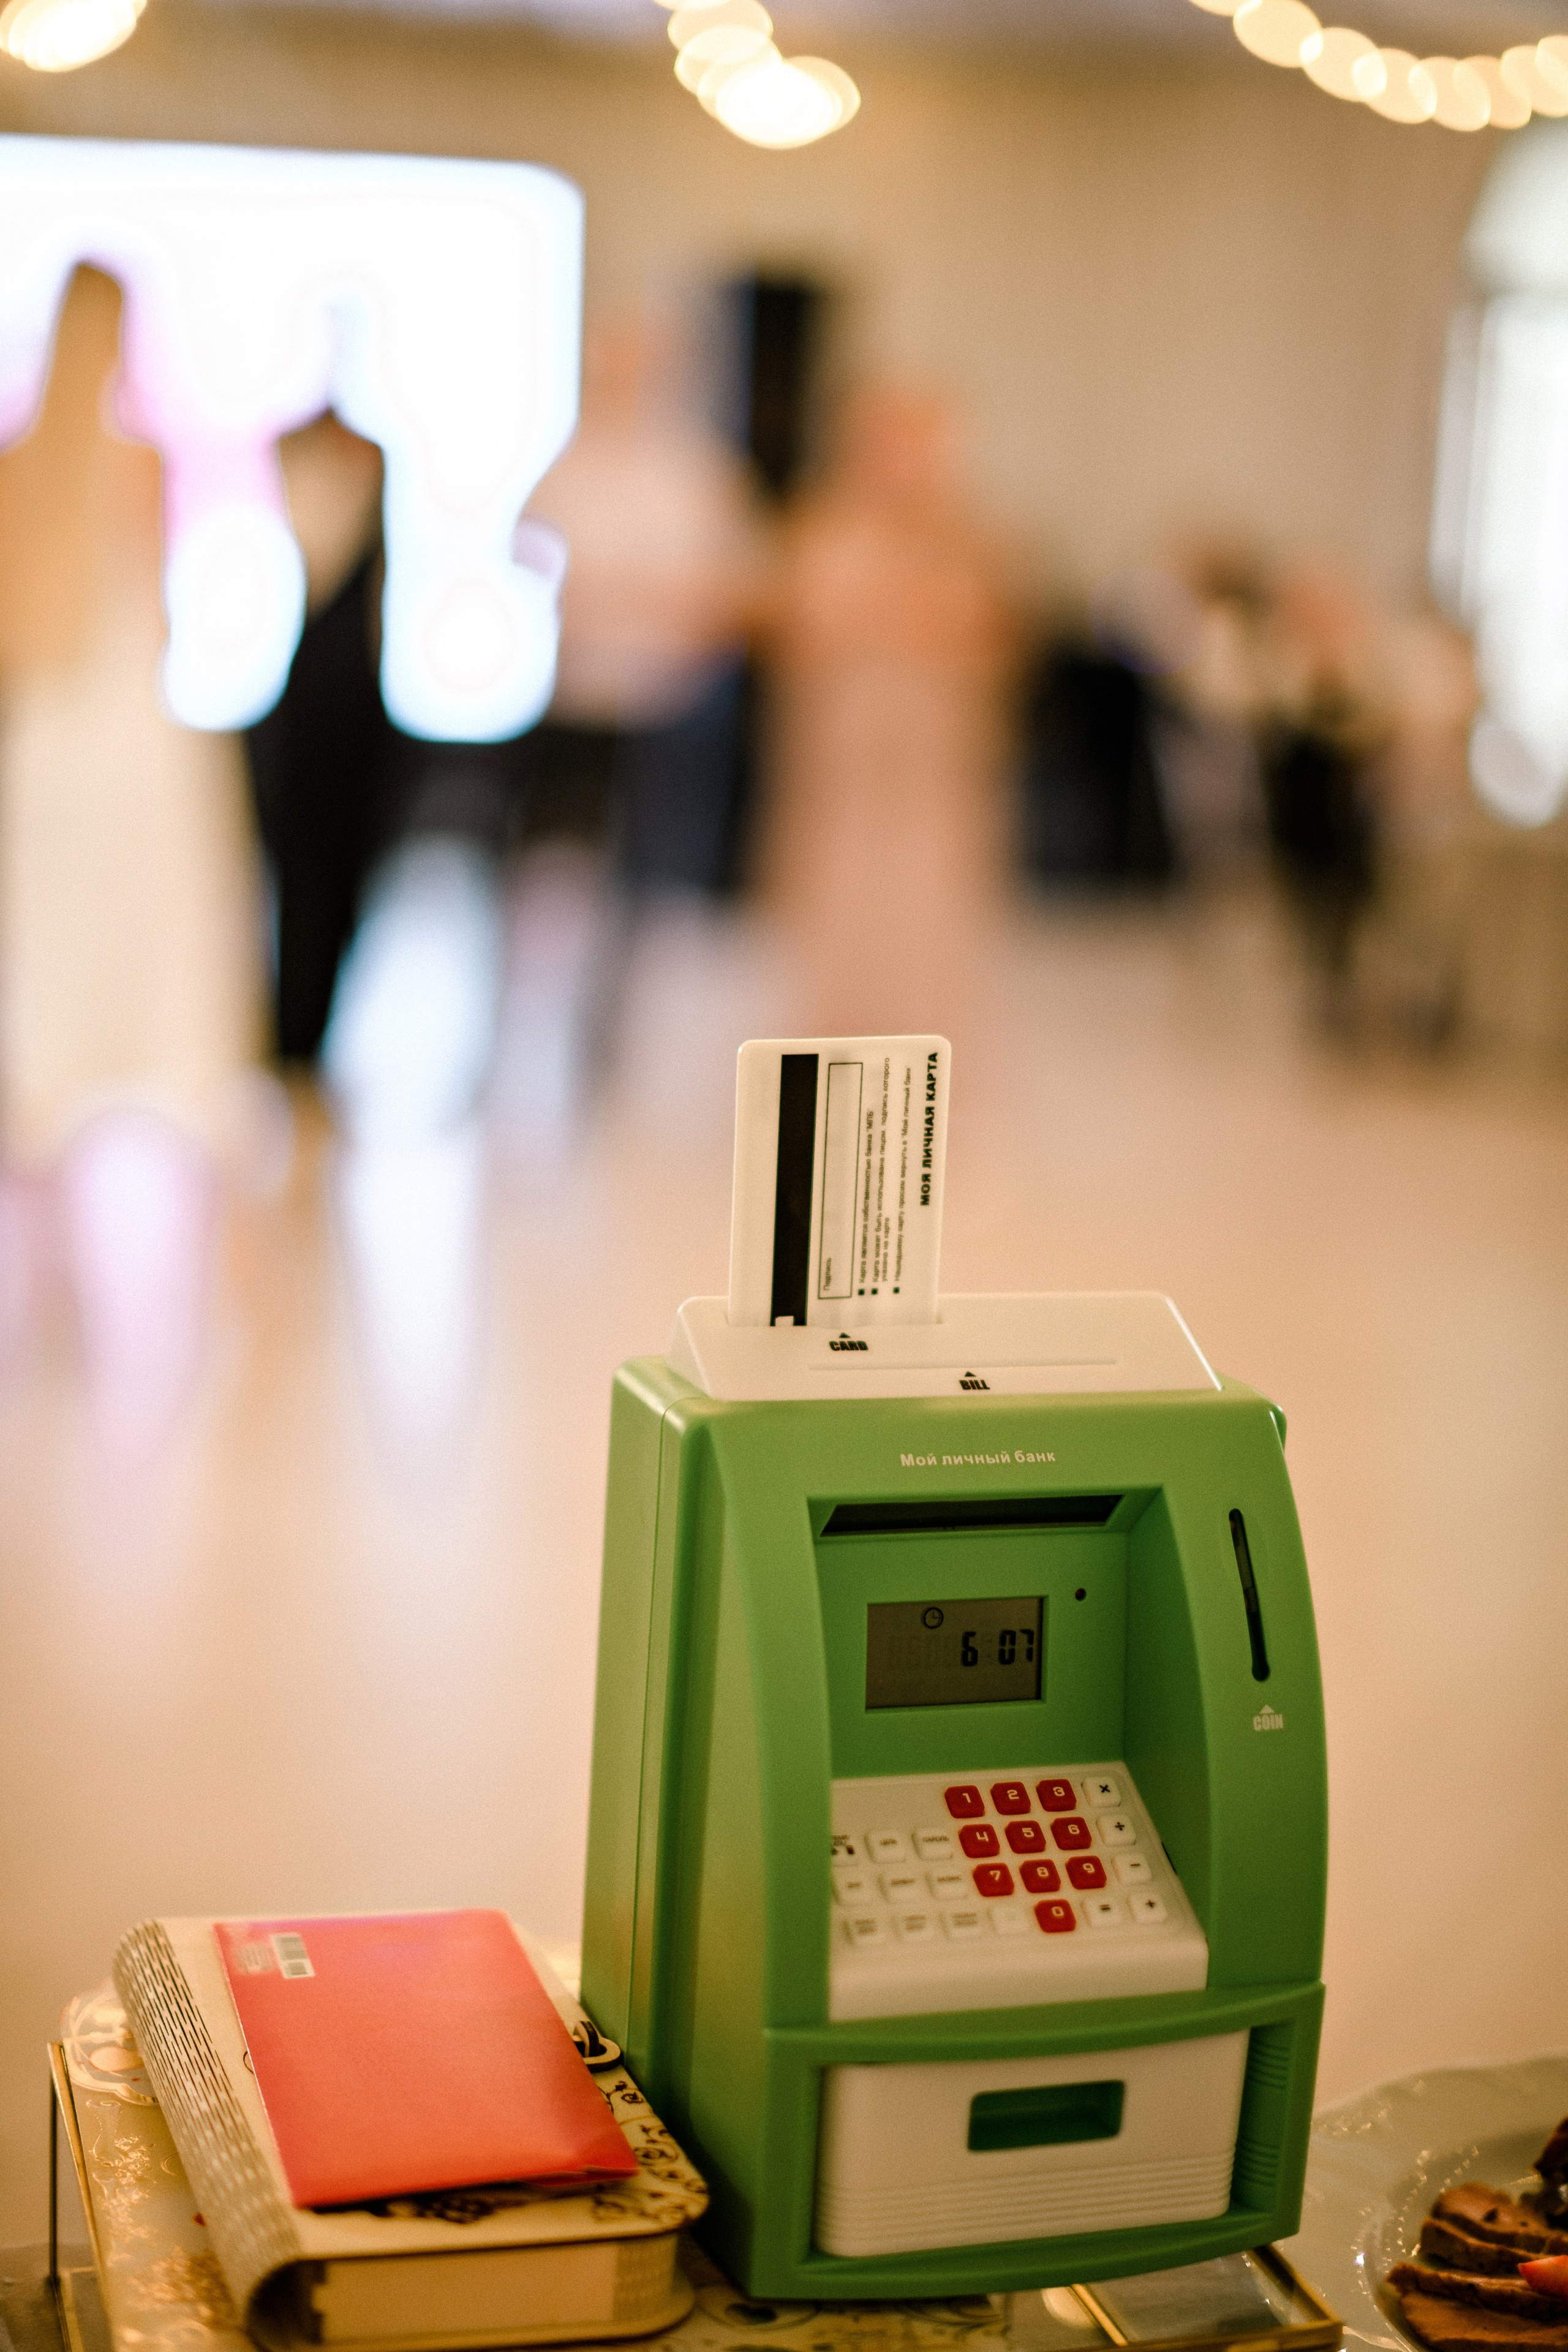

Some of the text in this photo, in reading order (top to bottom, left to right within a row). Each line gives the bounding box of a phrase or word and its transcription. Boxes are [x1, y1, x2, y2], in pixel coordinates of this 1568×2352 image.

[920, 1052, 938, 1206] МОЯ ЛИЧНАЯ КАРТА
[862, 1158, 871, 1221] собственностью
[894, 1234, 903, 1281] Нашедшему
[823, 1257, 832, 1291] Подпись
[829, 1341, 869, 1351] CARD
[959, 1379, 990, 1390] BILL
[900, 1450, 1057, 1467] Мой личный банк
[1253, 1714, 1284, 1732] COIN
[962, 1792, 971, 1803] 1
[1006, 1789, 1020, 1800] 2
[1052, 1786, 1066, 1797] 3
[975, 1831, 989, 1842] 4
[1021, 1827, 1035, 1838] 5
[1067, 1824, 1080, 1835] 6
[989, 1870, 1001, 1881] 7
[1036, 1866, 1049, 1877] 8
[1082, 1863, 1095, 1874] 9
[1051, 1905, 1065, 1917] 0
